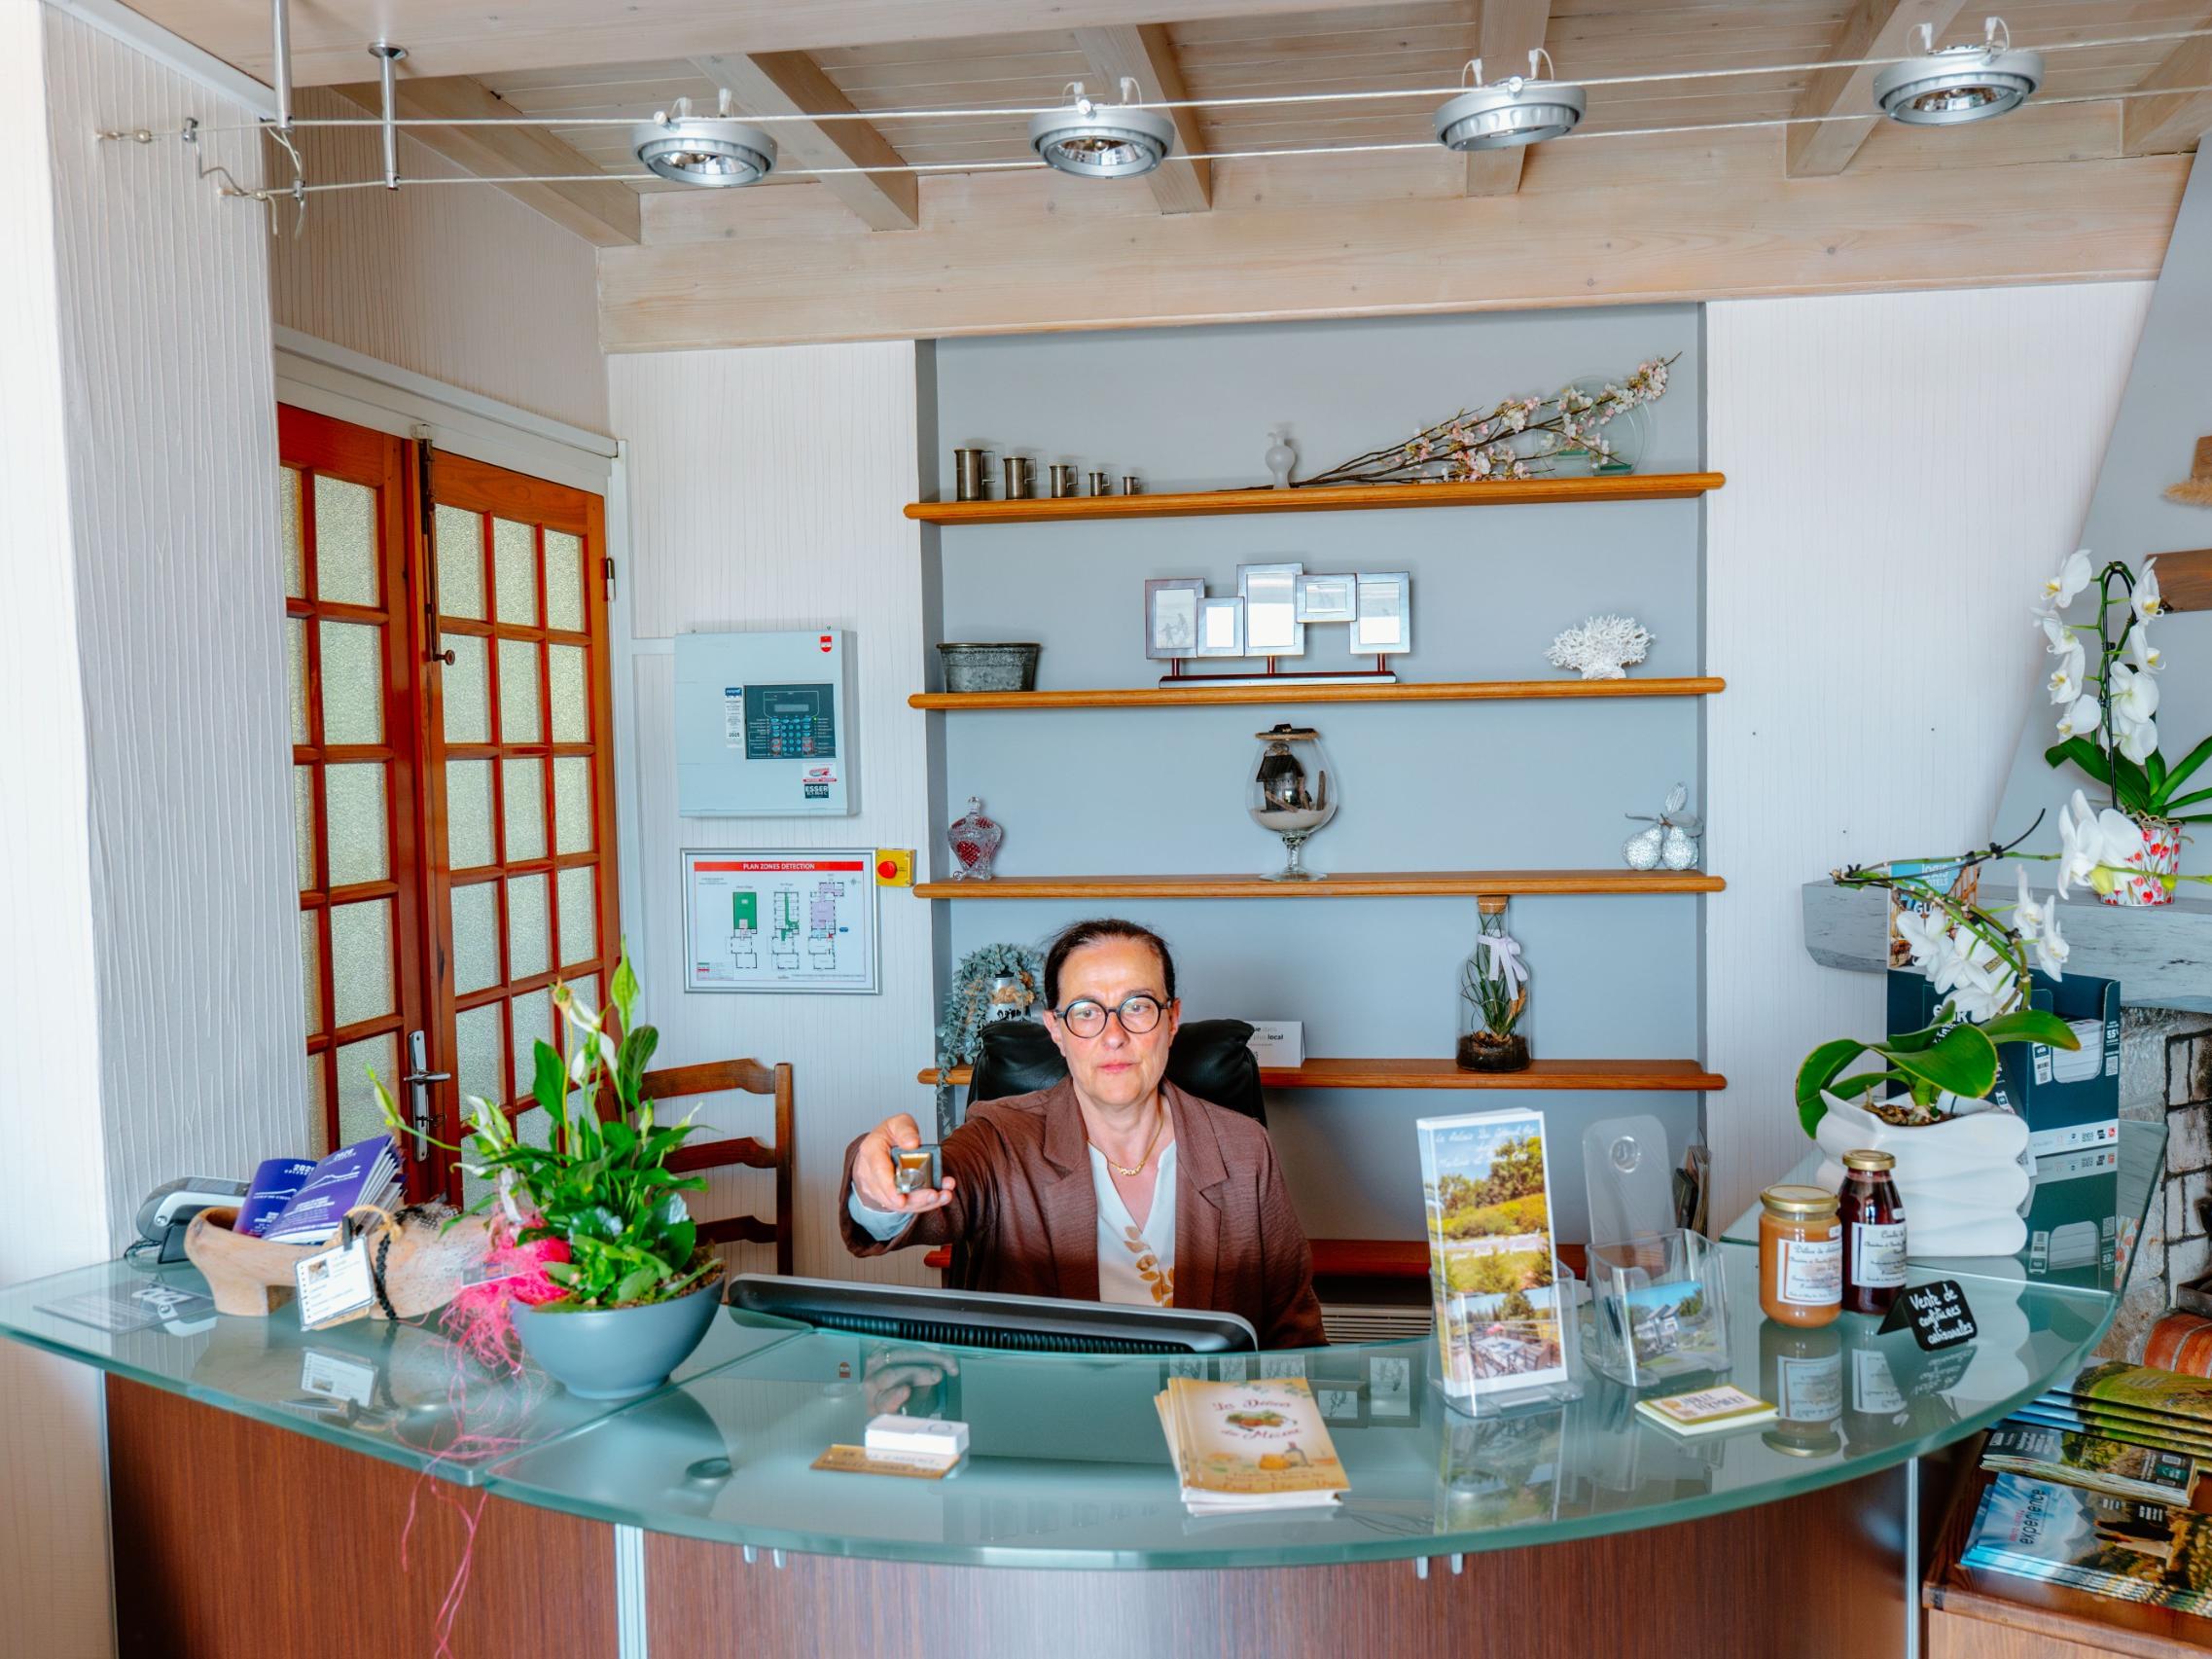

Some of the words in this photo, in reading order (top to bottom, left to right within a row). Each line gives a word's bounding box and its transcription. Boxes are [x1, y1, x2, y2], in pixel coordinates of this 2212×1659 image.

[1909, 1287, 1943, 1311] Vente
[1943, 1283, 1958, 1302] de
[1918, 1304, 1962, 1328] confitures
